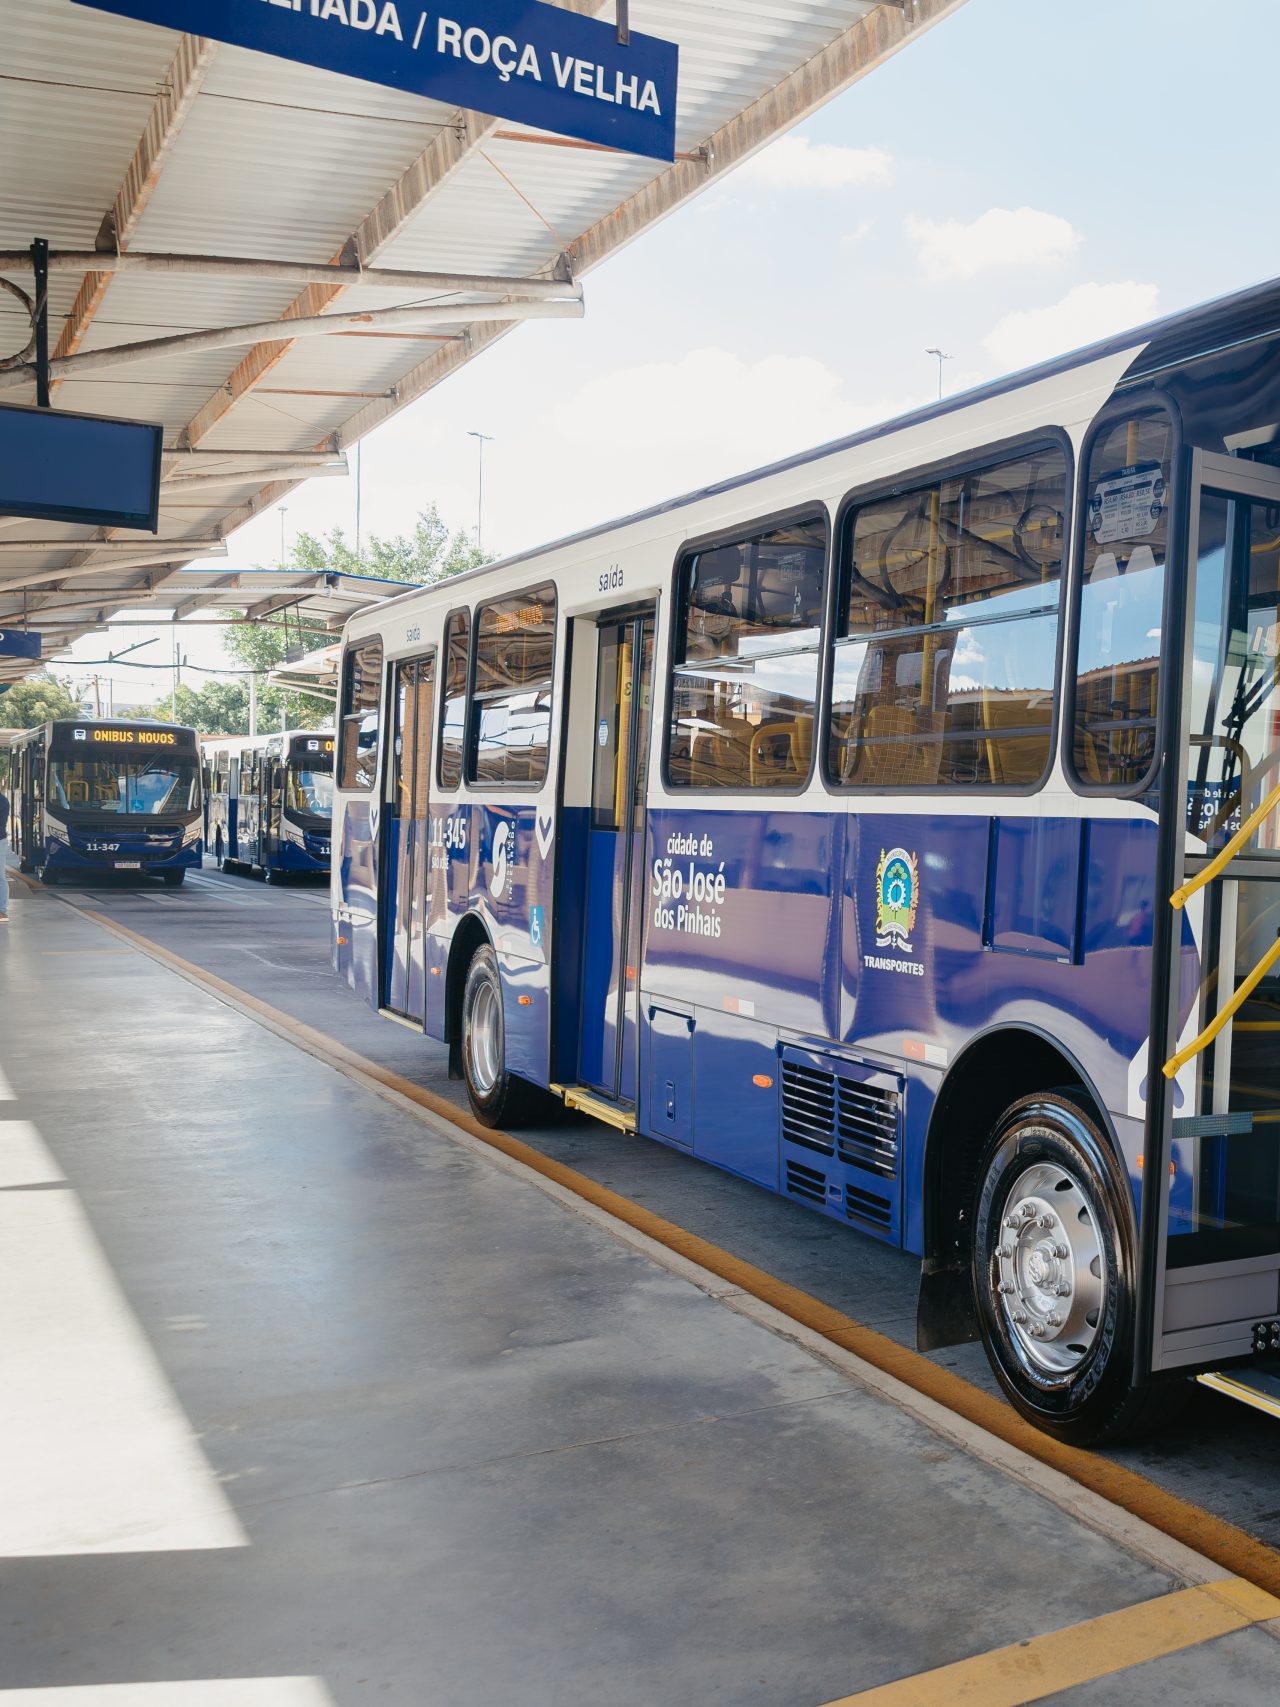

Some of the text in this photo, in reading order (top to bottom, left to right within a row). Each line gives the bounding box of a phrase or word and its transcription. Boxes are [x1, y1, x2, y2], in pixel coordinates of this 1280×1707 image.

[437, 18, 541, 82] ROÇA
[551, 52, 660, 115] VELHA
[598, 564, 624, 592] saída
[406, 624, 421, 642] saída
[94, 730, 175, 745] ONIBUS NOVOS
[432, 817, 466, 850] 11-345
[667, 832, 713, 857] cidade de
[86, 843, 120, 851] 11-347
[652, 857, 726, 905] São José
[654, 900, 721, 938] dos Pinhais
[863, 955, 925, 976] TRANSPORTES
